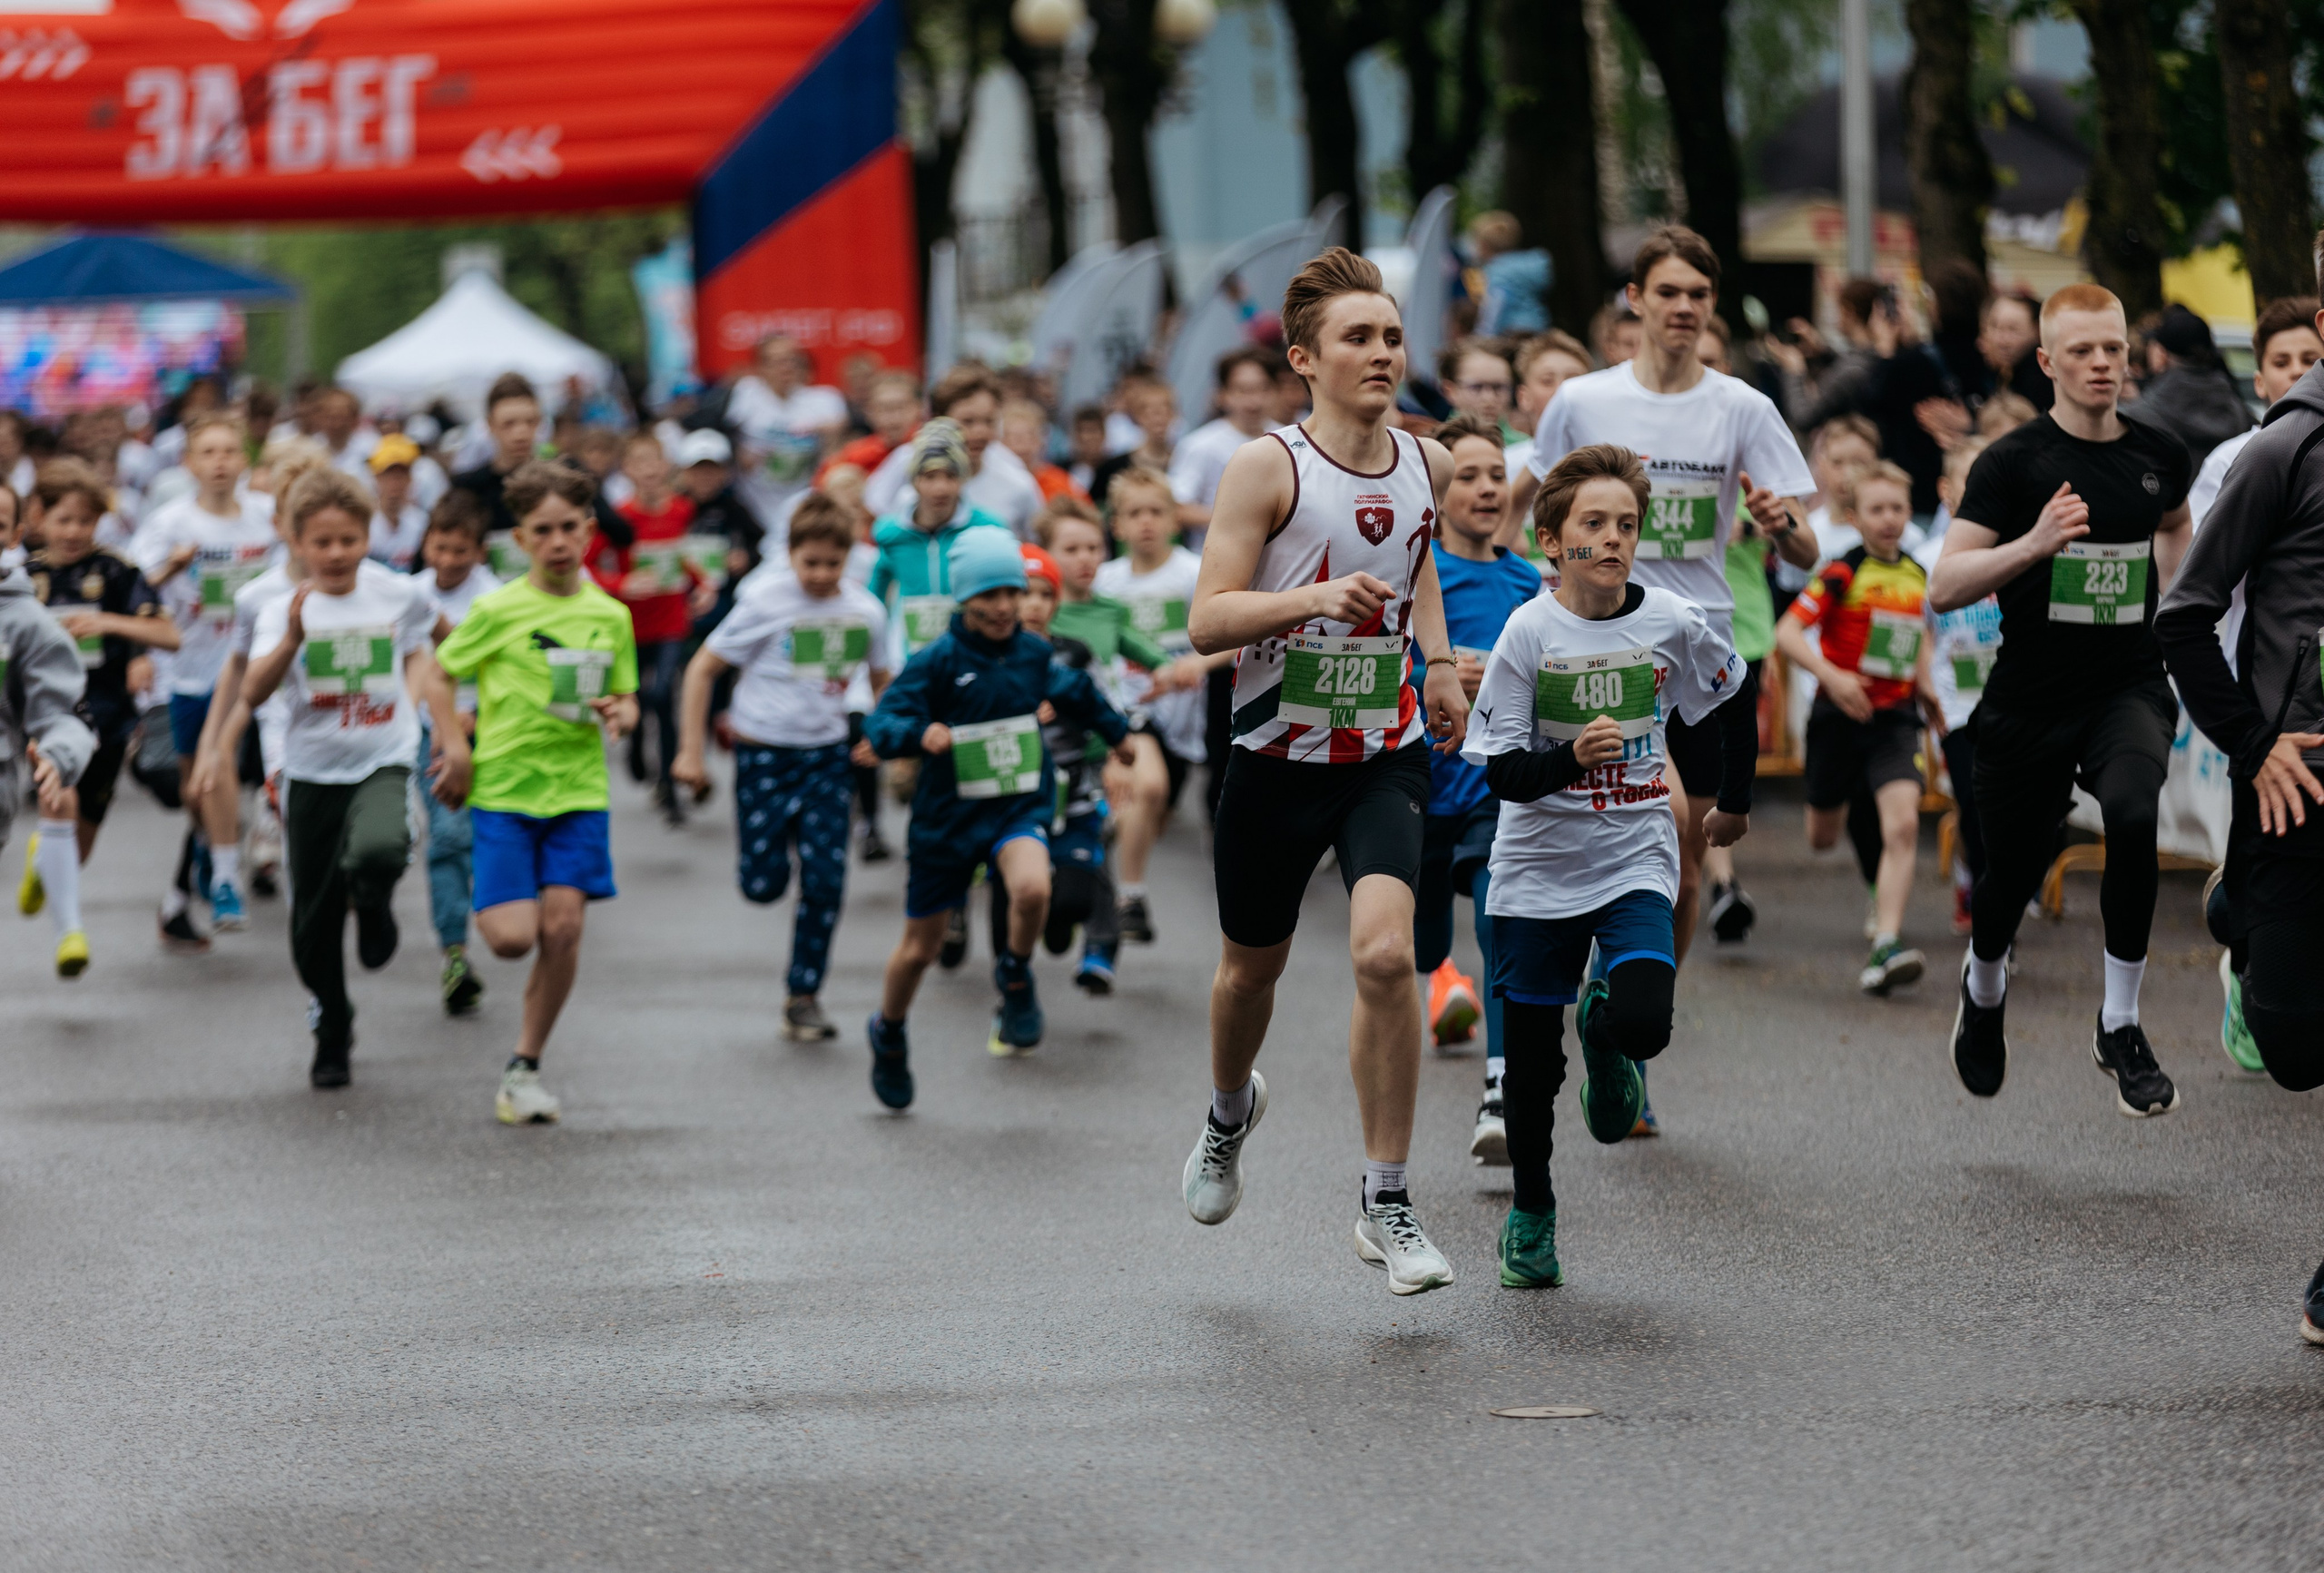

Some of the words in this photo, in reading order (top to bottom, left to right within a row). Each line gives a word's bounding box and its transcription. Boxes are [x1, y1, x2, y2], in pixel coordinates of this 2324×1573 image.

[1650, 498, 1695, 532] 344
[2083, 560, 2128, 595] 223
[1306, 641, 1324, 650] ПСБ
[1315, 656, 1377, 694] 2128
[1552, 663, 1569, 671] ПСБ
[1332, 696, 1356, 706] ЕВГЕНИЙ
[1571, 671, 1623, 711] 480
